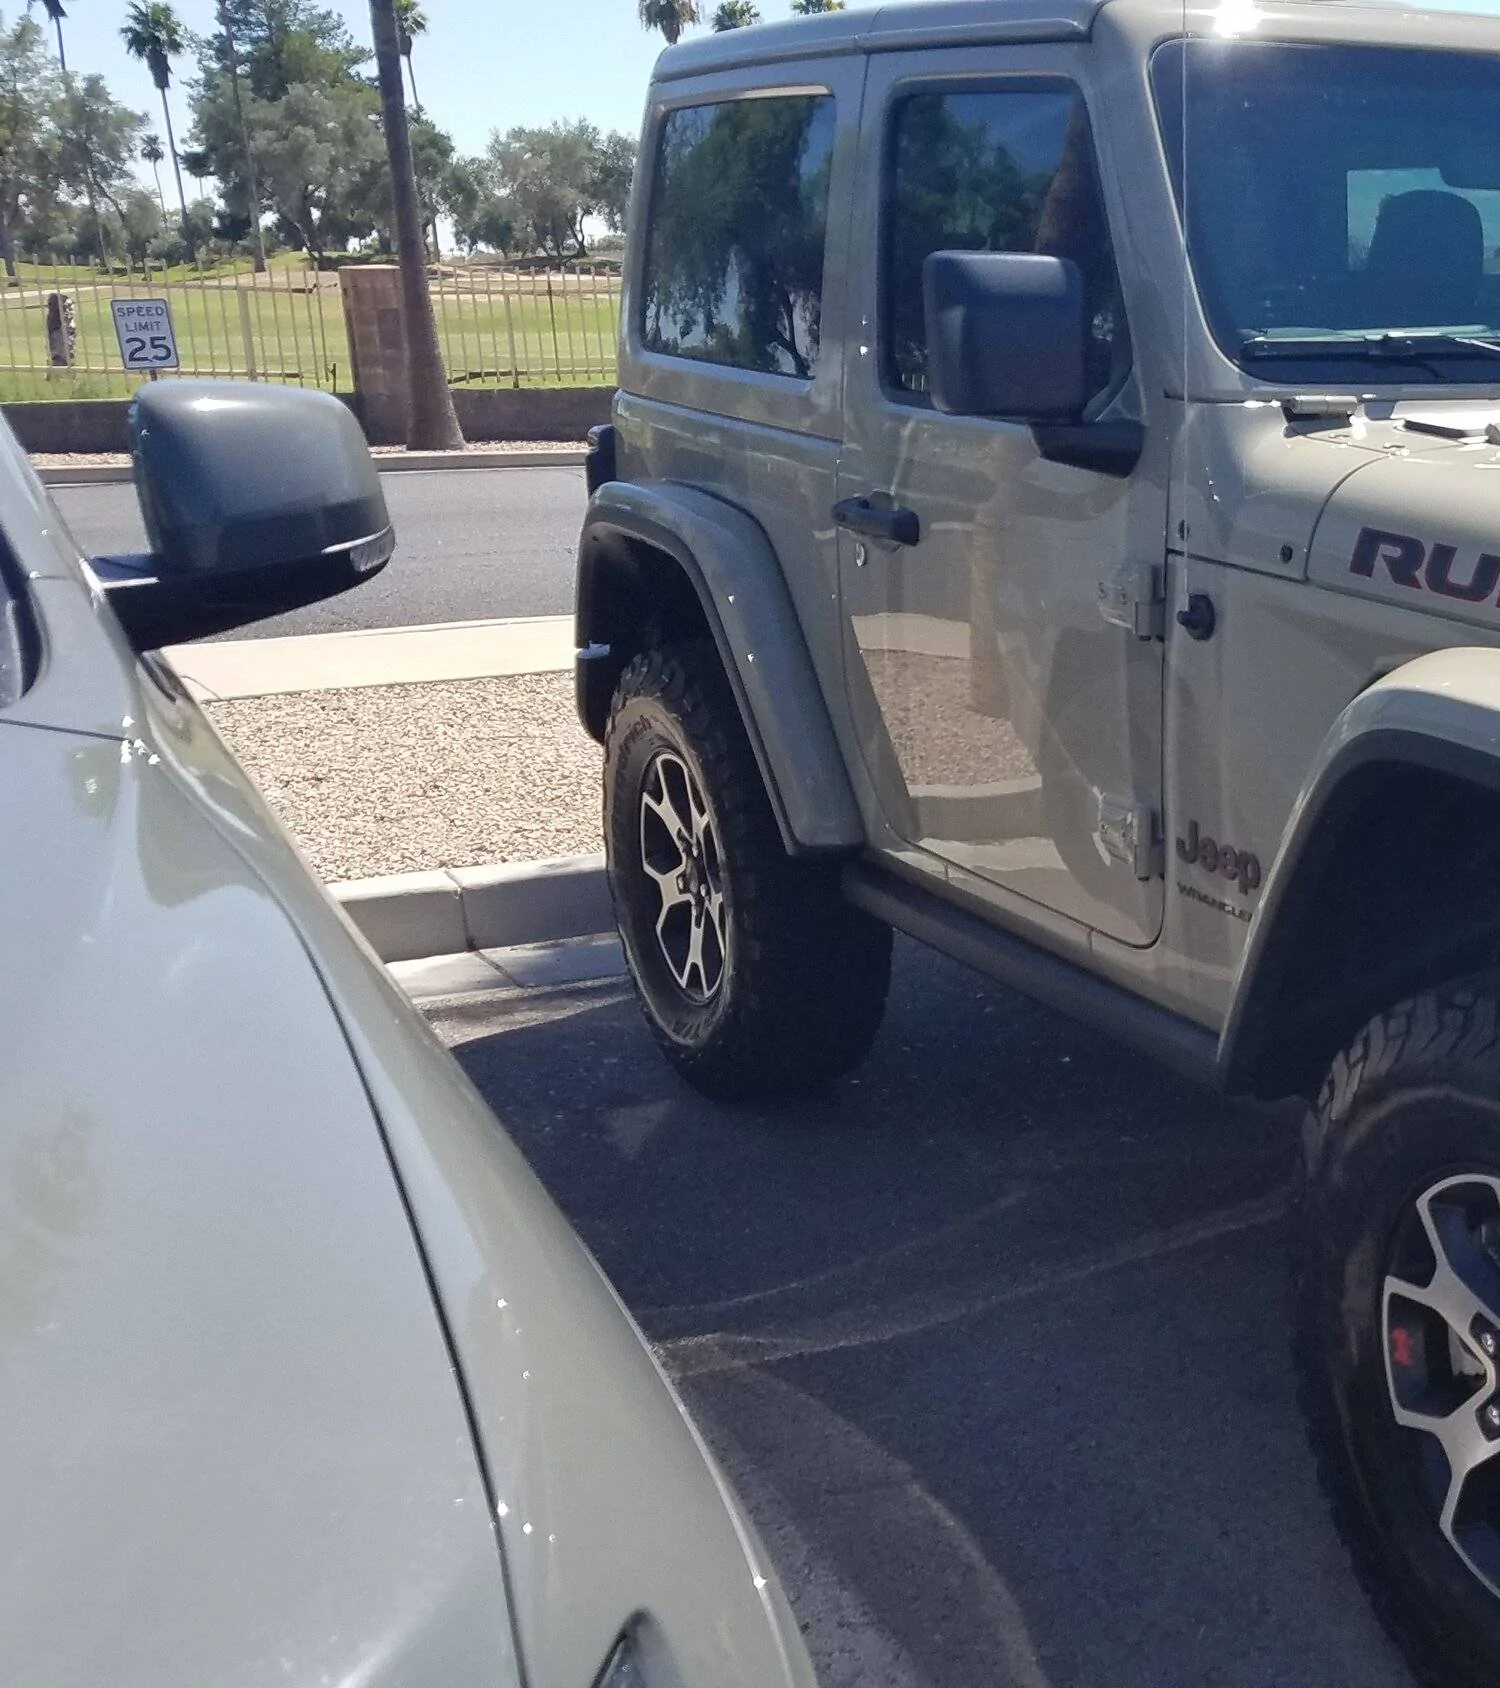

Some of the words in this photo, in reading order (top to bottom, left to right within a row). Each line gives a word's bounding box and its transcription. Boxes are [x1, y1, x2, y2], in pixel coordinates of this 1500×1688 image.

[117, 306, 164, 317] SPEED
[125, 321, 161, 332] LIMIT
[125, 336, 172, 362] 25
[1176, 820, 1261, 896] Jeep
